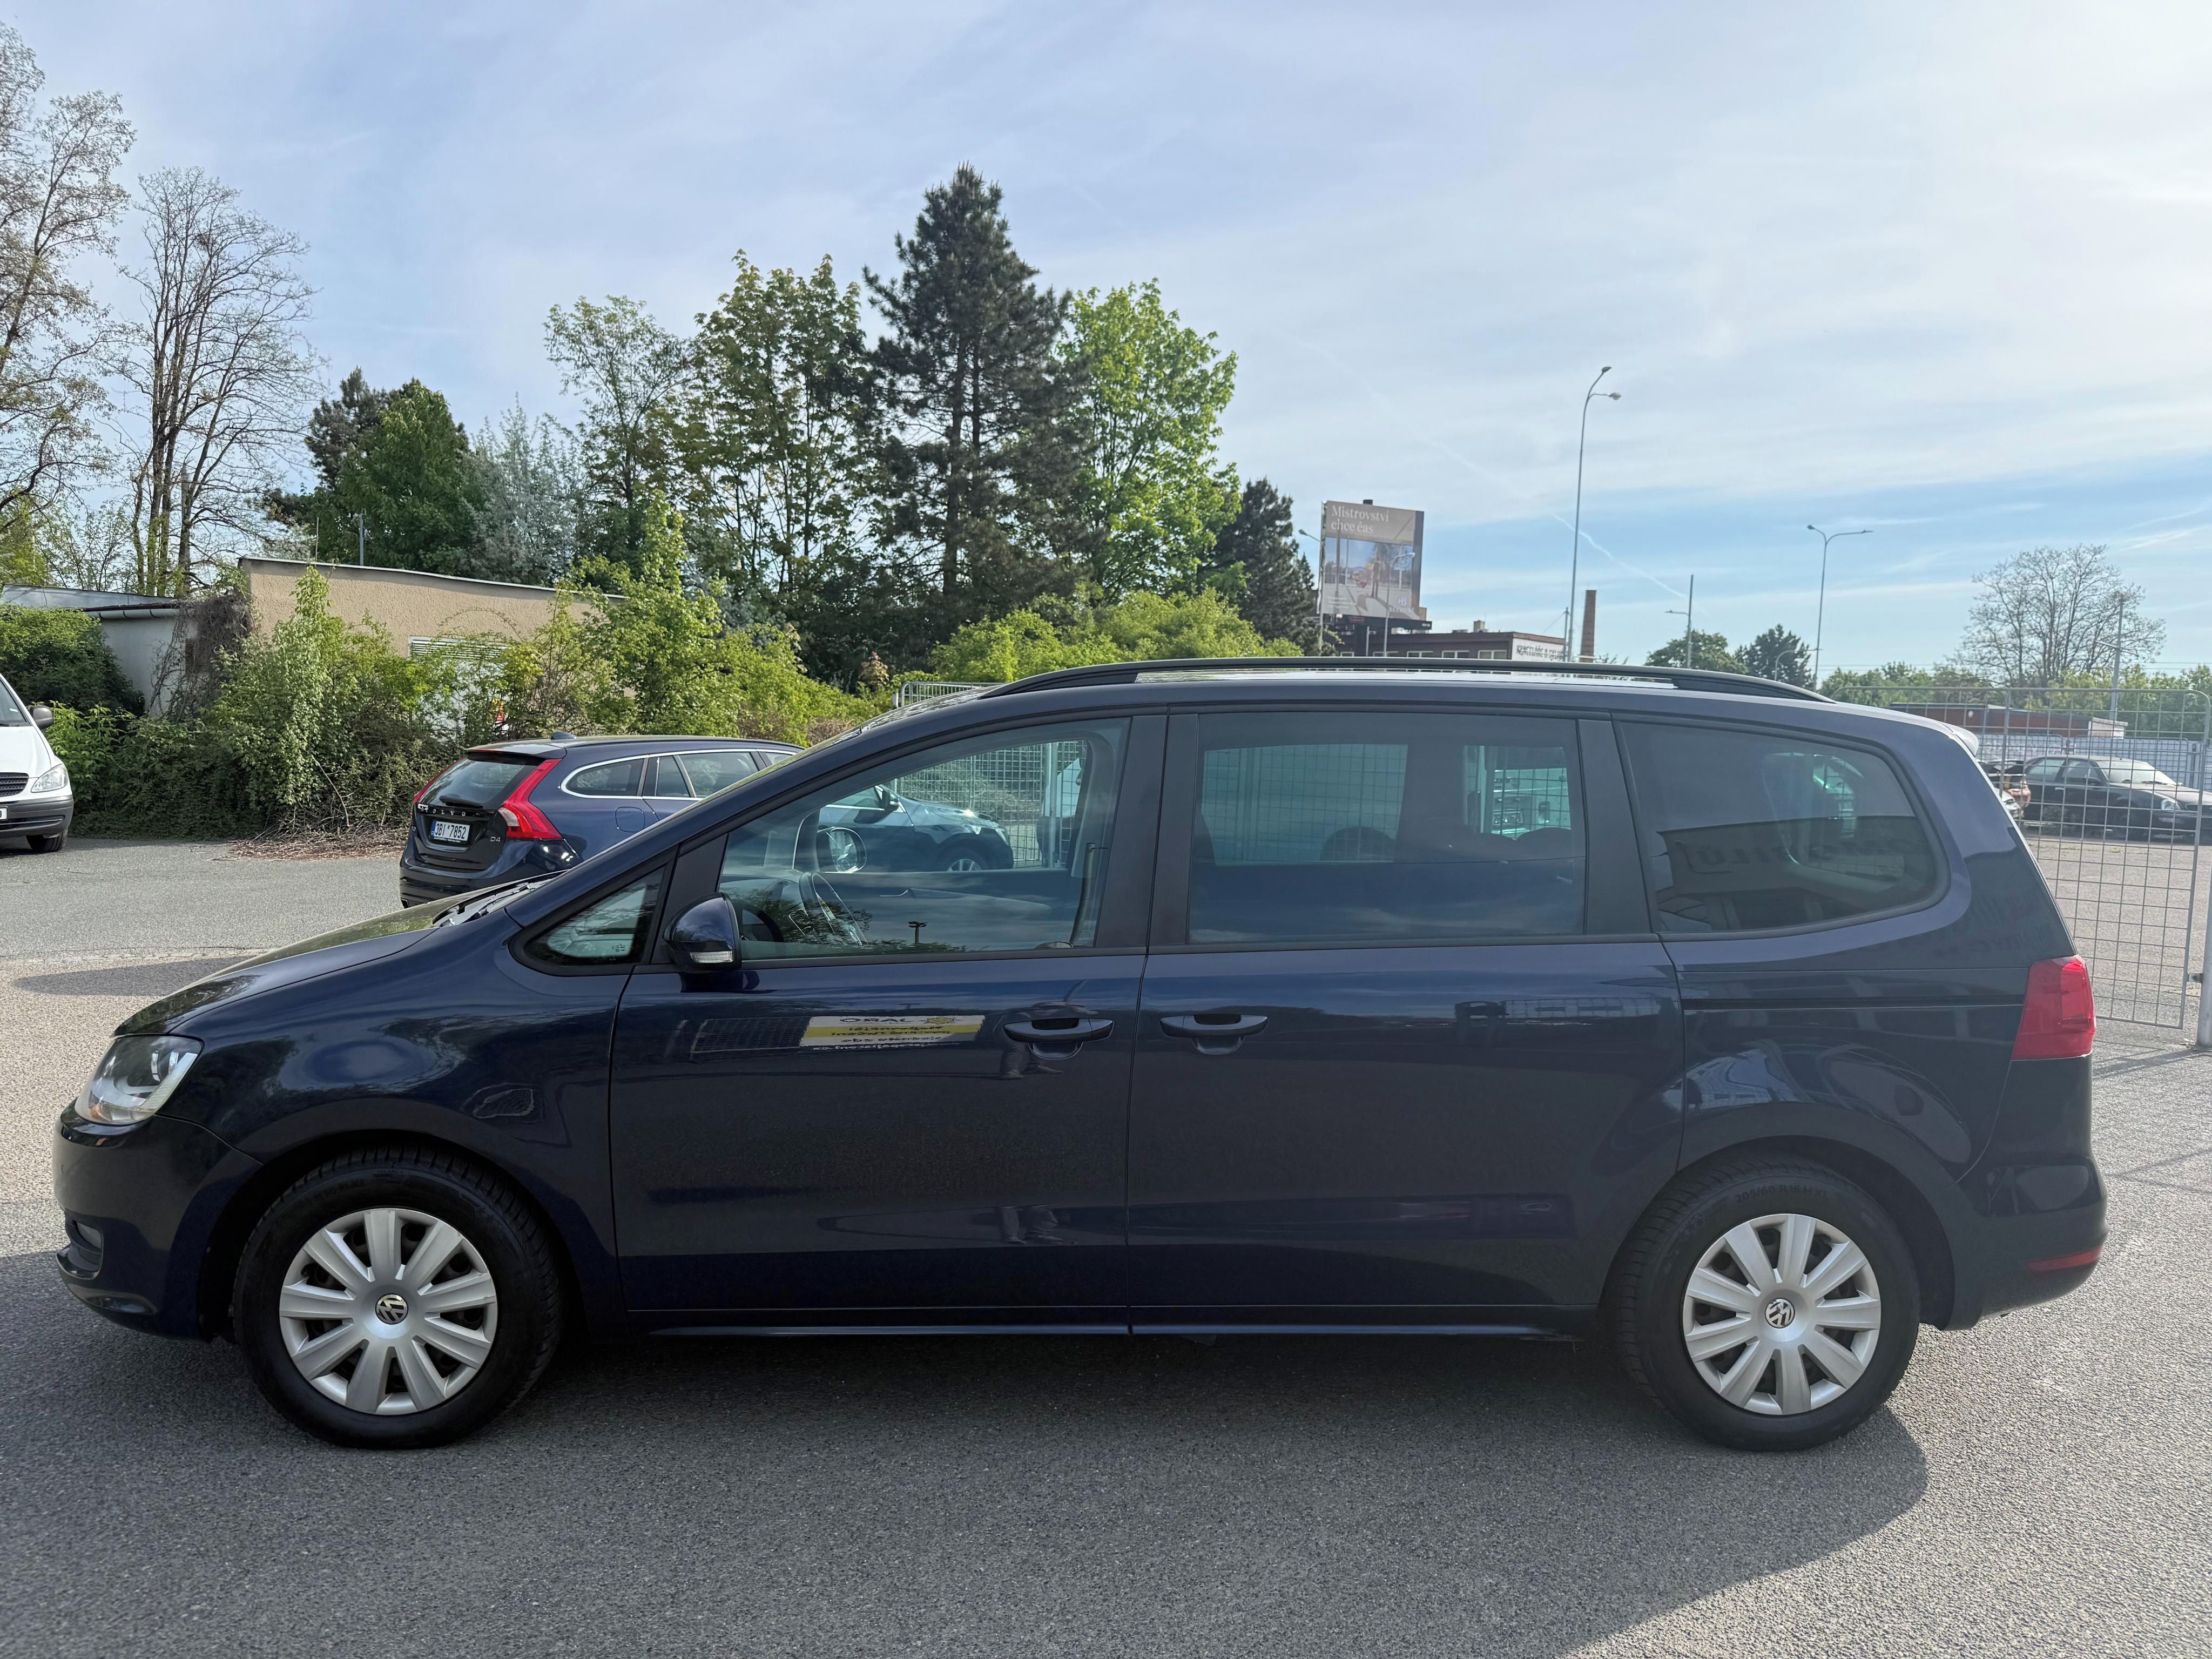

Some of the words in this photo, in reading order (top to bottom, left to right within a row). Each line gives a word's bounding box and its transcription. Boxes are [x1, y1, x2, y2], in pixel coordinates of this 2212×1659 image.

[1332, 505, 1389, 522] Mistrovství
[1331, 518, 1355, 531] chce
[1357, 521, 1373, 533] čas
[435, 824, 445, 837] 3BI
[449, 825, 467, 839] 7852
